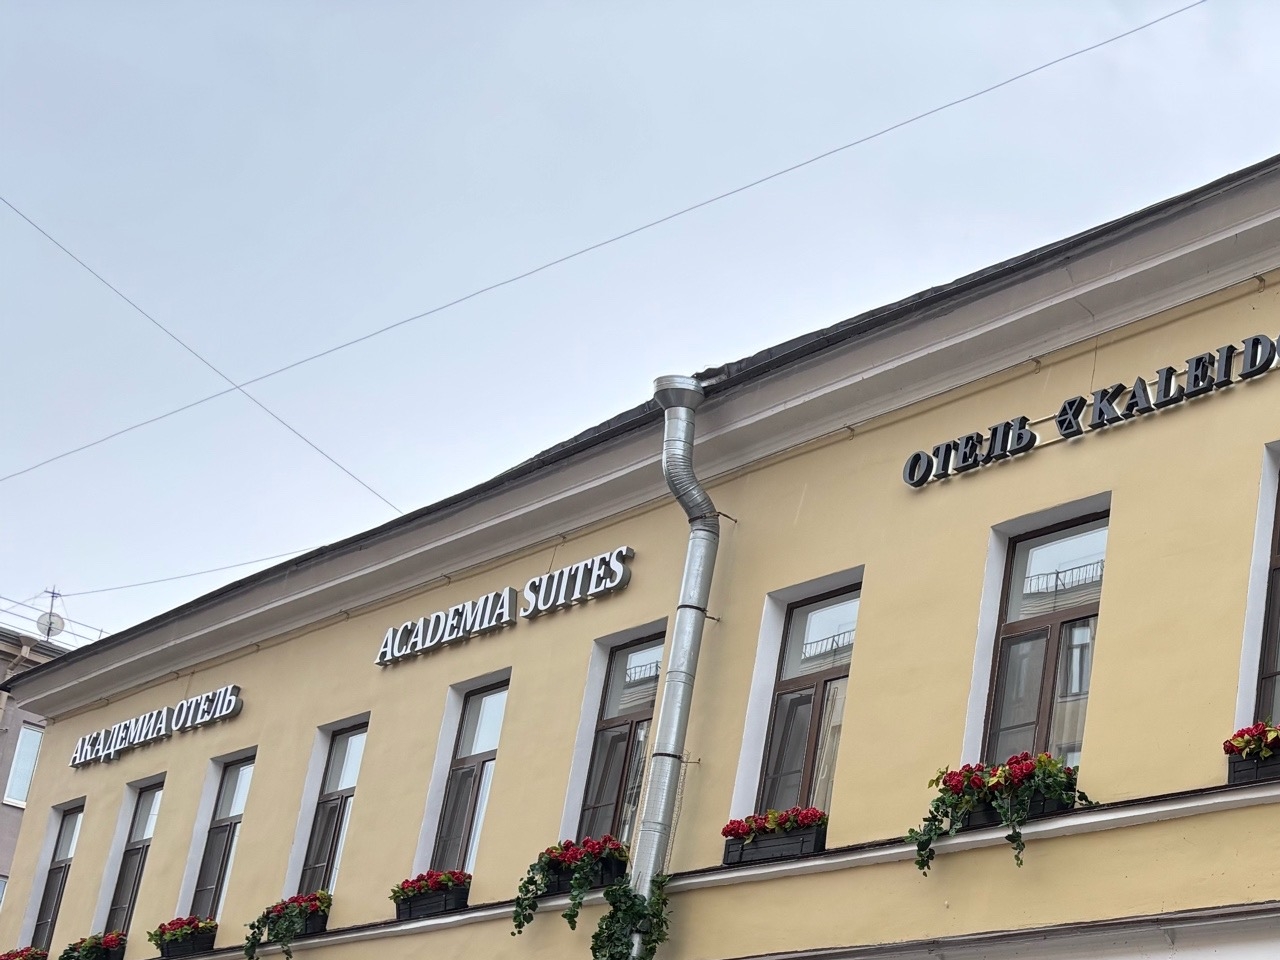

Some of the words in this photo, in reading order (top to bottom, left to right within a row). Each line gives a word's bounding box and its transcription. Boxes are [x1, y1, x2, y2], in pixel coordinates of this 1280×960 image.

[902, 415, 1036, 489] ОТЕЛЬ
[374, 586, 517, 667] ACADEMIA
[520, 546, 635, 619] SUITES
[68, 706, 175, 768] АКАДЕМИА
[171, 684, 243, 731] ОТЕЛЬ
